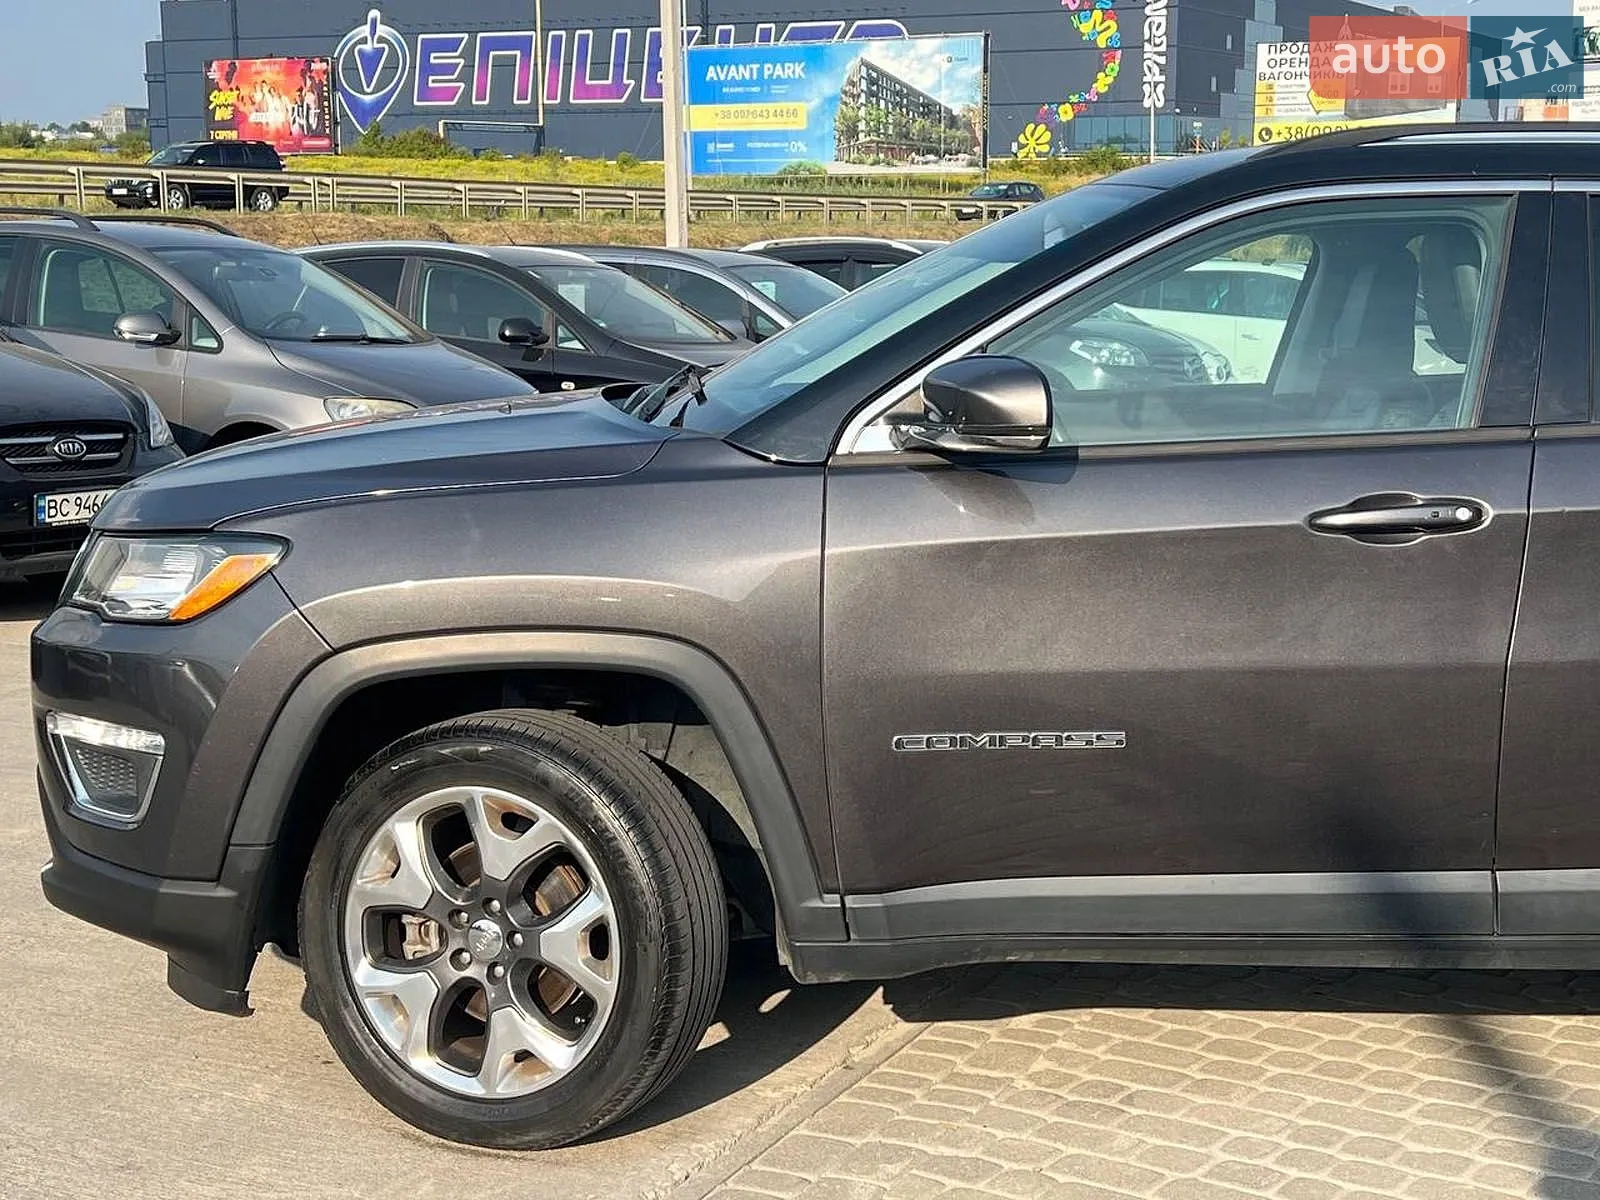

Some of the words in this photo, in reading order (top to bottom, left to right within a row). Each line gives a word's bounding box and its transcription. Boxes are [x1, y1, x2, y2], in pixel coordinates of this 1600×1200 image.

[705, 63, 761, 81] AVANT
[763, 61, 806, 80] PARK
[1266, 57, 1333, 70] ОРЕНДА
[1258, 70, 1346, 82] ВАГОНЧИКІВ
[60, 442, 82, 454] KIA
[47, 498, 70, 519] BC
[892, 731, 1127, 751] COMPASS
